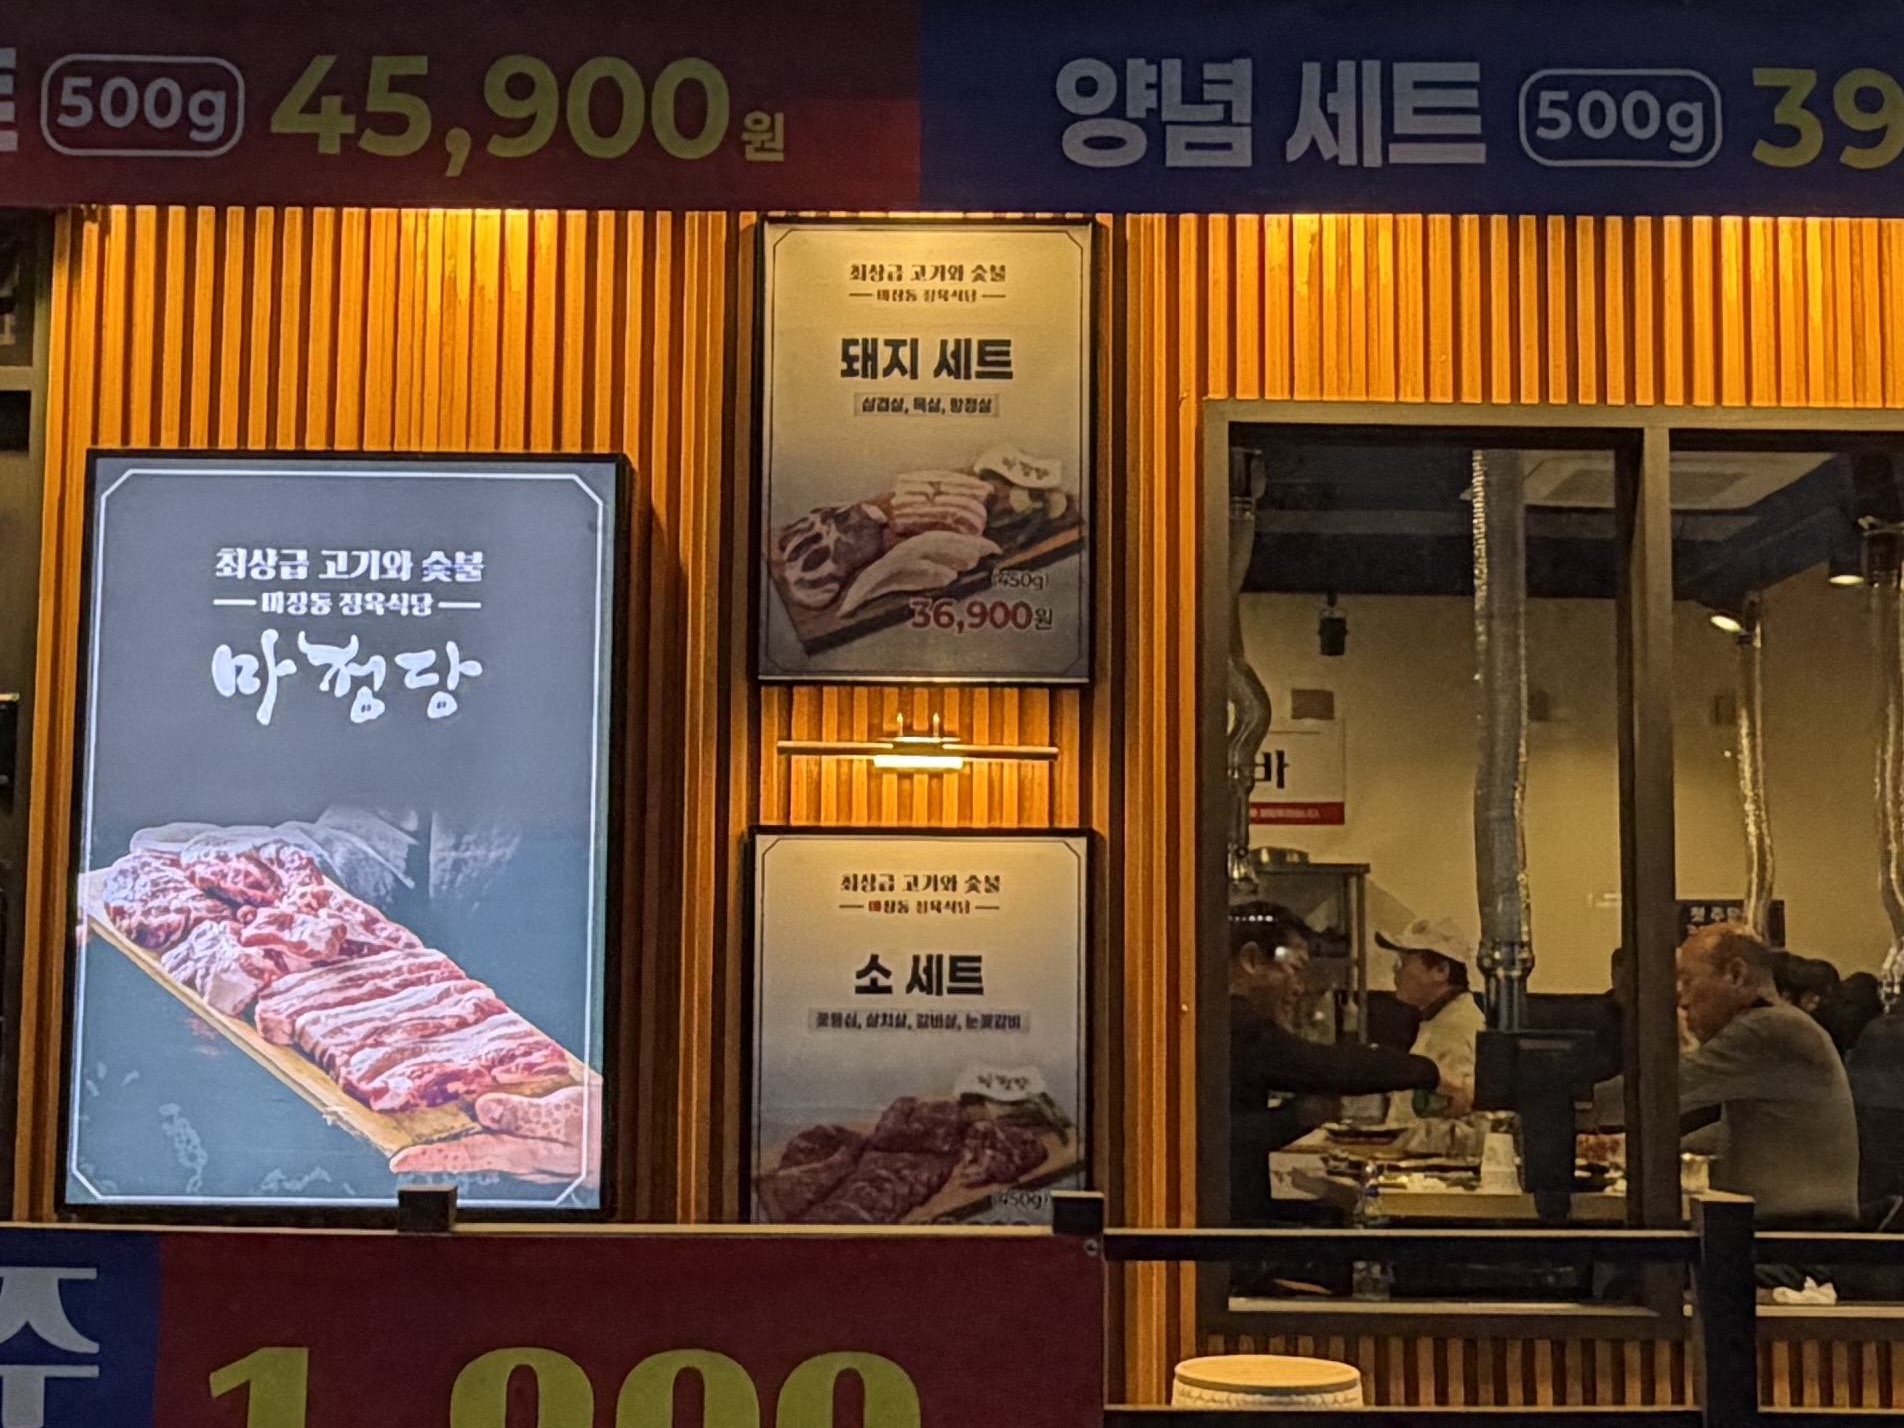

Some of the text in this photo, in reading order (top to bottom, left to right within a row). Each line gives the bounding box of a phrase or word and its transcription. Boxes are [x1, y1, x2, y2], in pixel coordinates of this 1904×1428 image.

[55, 74, 229, 144] 500g
[1054, 57, 1254, 169] 양념
[1285, 59, 1486, 169] 세트
[1534, 88, 1705, 157] 500g
[841, 337, 1013, 380] 돼지 세트
[215, 547, 485, 583] 최상급 고기와 숯불
[212, 628, 483, 726] 마정당
[855, 954, 984, 996] 소 세트
